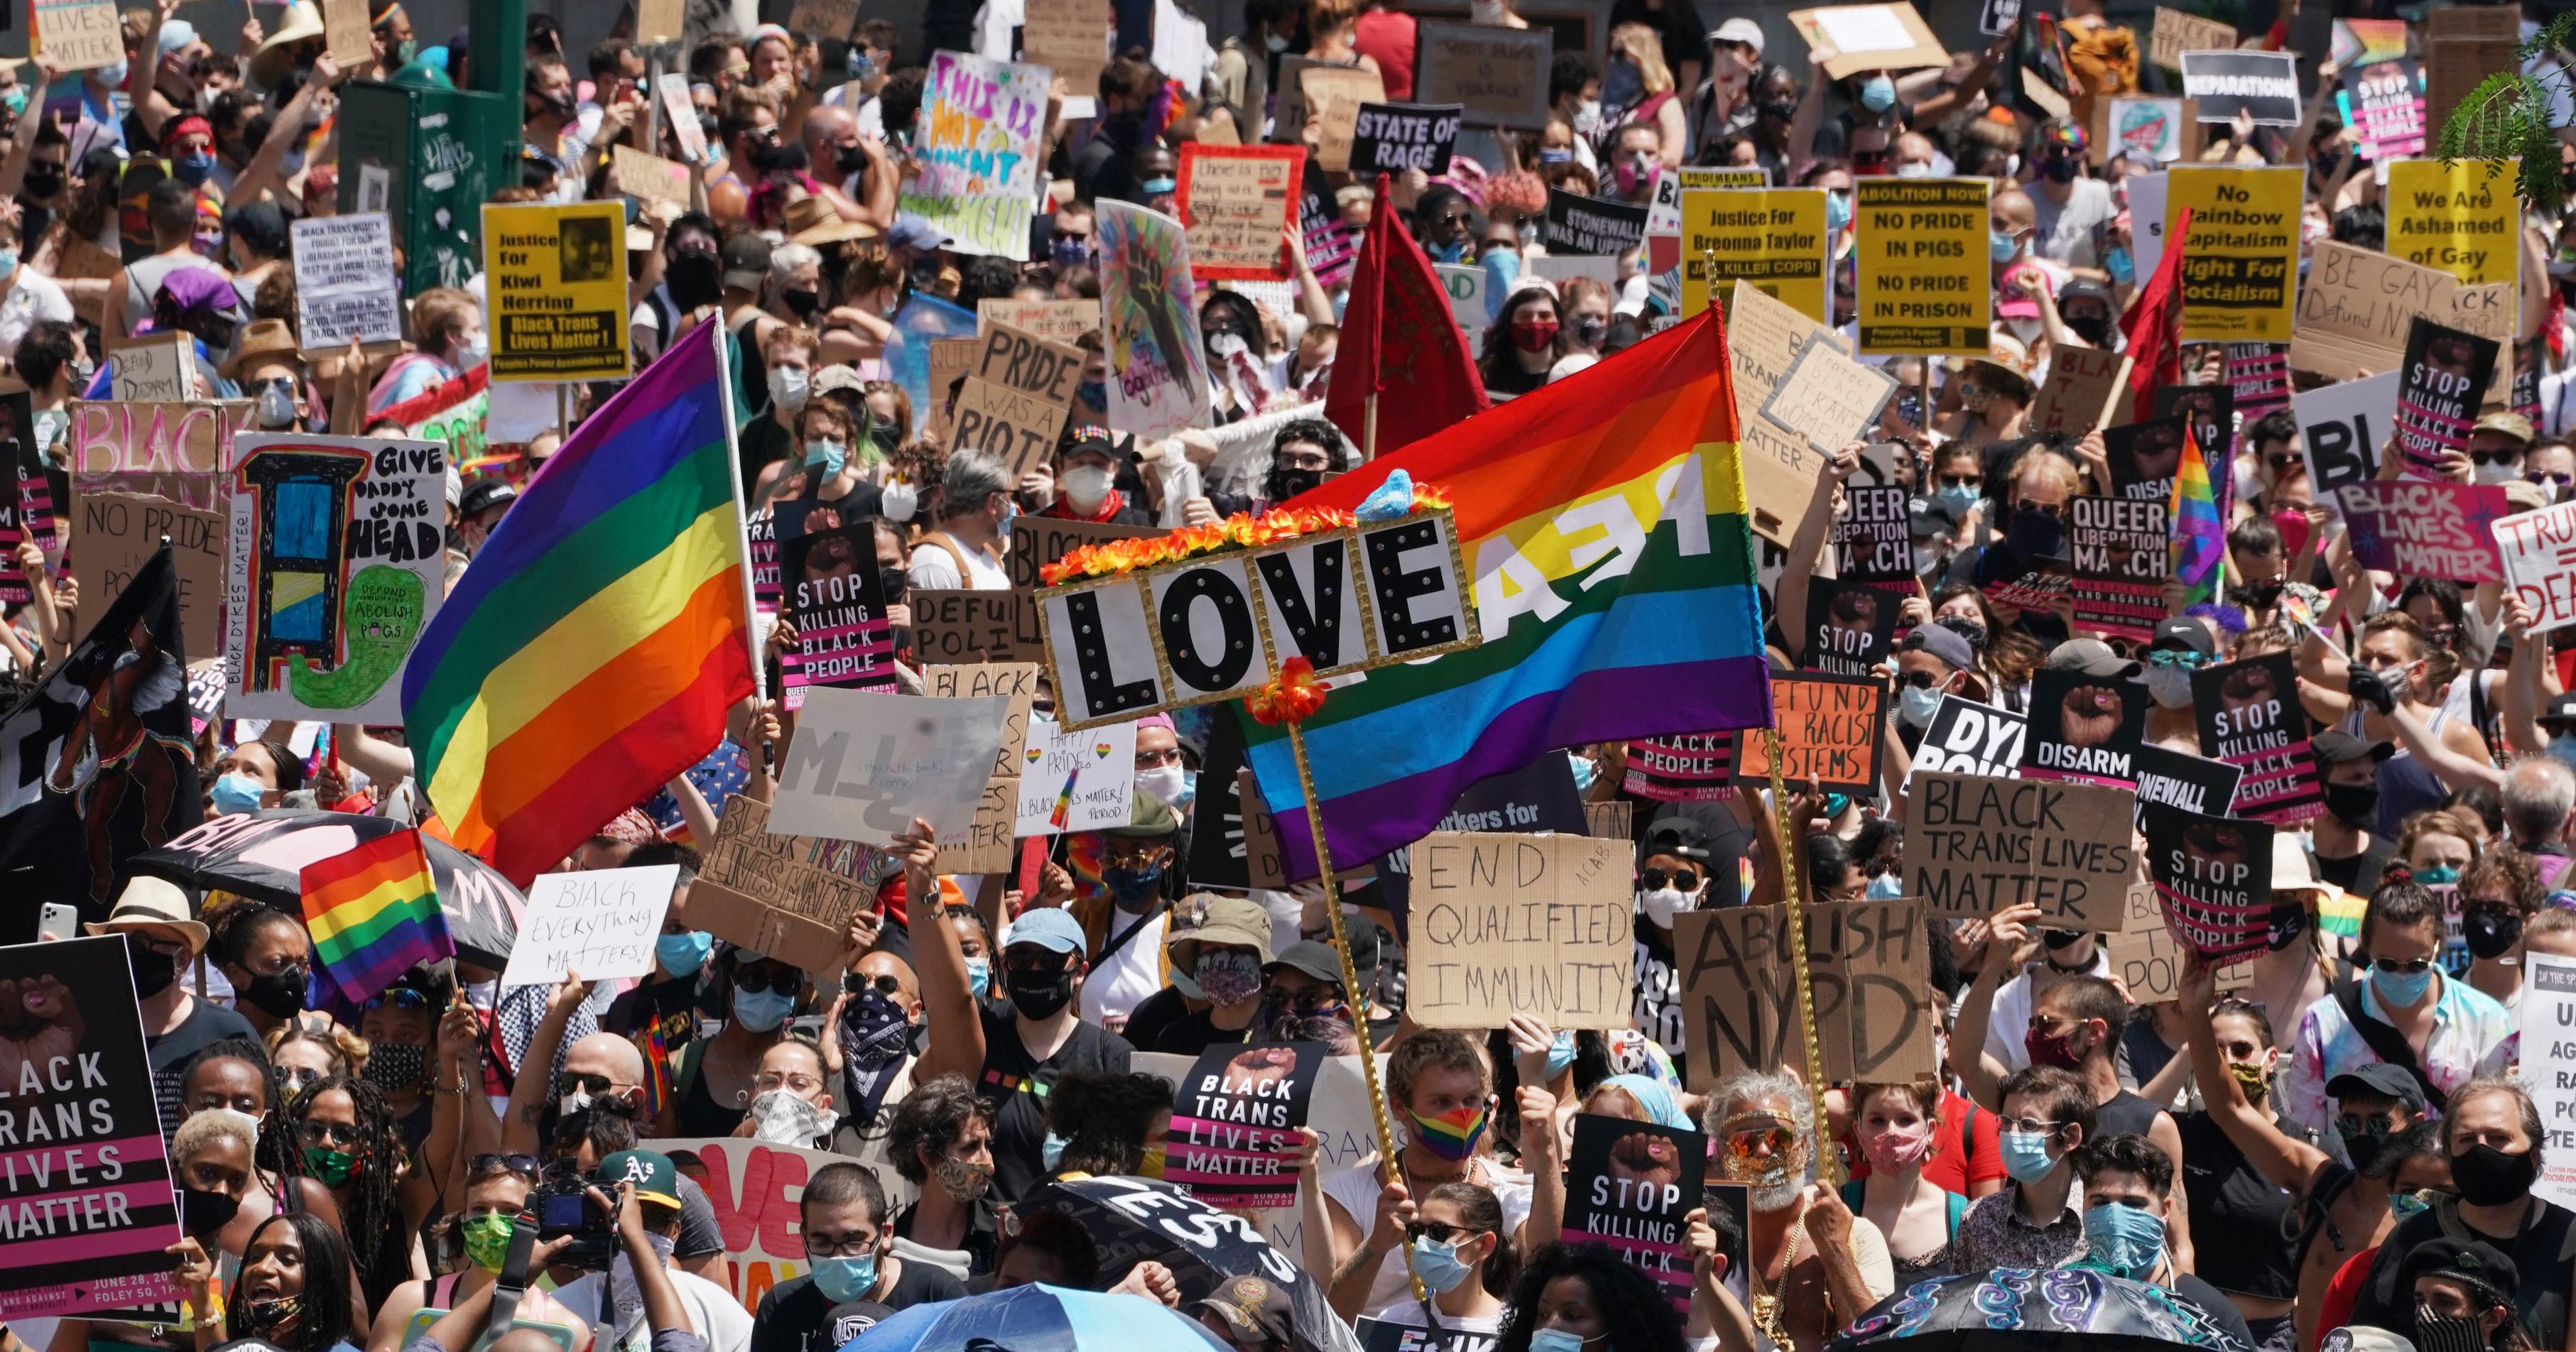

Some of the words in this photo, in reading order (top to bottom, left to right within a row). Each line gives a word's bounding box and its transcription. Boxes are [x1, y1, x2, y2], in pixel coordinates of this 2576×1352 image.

[47, 36, 117, 61] MATTER
[936, 54, 999, 119] THIS
[2185, 75, 2298, 99] REPARATIONS
[2358, 75, 2409, 100] STOP
[2362, 91, 2414, 114] KILLING
[930, 98, 985, 148] NOT
[1356, 112, 1420, 143] STATE
[1433, 115, 1460, 142] OF
[1374, 141, 1437, 169] RAGE
[1859, 183, 1941, 202] ABOLITION
[1946, 182, 1987, 201] NOW!
[2217, 185, 2250, 204] No
[2413, 190, 2447, 209] We
[2454, 190, 2493, 209] Are
[1566, 207, 1642, 239] STONEWALL
[1710, 207, 1767, 228] Justice
[1770, 207, 1795, 225] For
[1874, 212, 1904, 231] NO
[1909, 212, 1974, 231] PRIDE
[2190, 207, 2284, 226] ainbow
[2400, 215, 2506, 235] Ashamed
[499, 235, 558, 247] Justice
[1548, 219, 1575, 244] WAS
[1577, 229, 1597, 250] AN
[1692, 234, 1761, 253] Breonna
[1766, 232, 1816, 251] Taylor
[1886, 241, 1908, 258] IN
[1913, 241, 1965, 258] PIGS
[499, 253, 528, 267] For
[1724, 261, 1771, 276] KILLER
[1773, 258, 1817, 274] COPS!
[2246, 257, 2284, 278] For
[2408, 246, 2435, 266] of
[2440, 247, 2489, 269] Gay
[500, 274, 541, 290] Kiwi
[1876, 275, 1904, 292] NO
[1908, 275, 1969, 292] PRIDE
[2325, 249, 2366, 290] BE
[2381, 263, 2443, 310] GAY
[502, 294, 575, 311] Herring
[1874, 302, 1894, 319] IN
[1899, 302, 1973, 320] PRISON
[2304, 289, 2376, 329] Defund
[511, 319, 553, 334] Black
[558, 315, 599, 332] Trans
[511, 334, 550, 350] Lives
[554, 332, 600, 349] Matter
[979, 328, 1080, 403] PRIDE
[124, 379, 175, 400] DISARM
[1810, 365, 1866, 410] BLACK
[2411, 363, 2471, 399] STOP
[983, 386, 1034, 420] WAS
[1036, 404, 1054, 432] A
[1797, 384, 1856, 427] TRANS
[2406, 388, 2463, 419] KILLING
[74, 403, 254, 474] BLACK
[1776, 396, 1849, 452] WOMEN
[2401, 412, 2456, 440] BLACK
[952, 408, 1052, 475] RIOT!
[2400, 428, 2451, 453] PEOPLE
[375, 447, 444, 478] GIVE
[355, 479, 416, 499] DADDY
[2339, 484, 2464, 516] BLACK
[370, 499, 429, 519] SOME
[2072, 498, 2165, 535] QUEER
[85, 502, 129, 537] NO
[143, 508, 221, 557] PRIDE
[345, 519, 441, 563] HEAD
[2072, 528, 2166, 551] LIBERATION
[2377, 511, 2473, 547] LIVES
[2393, 542, 2501, 582] MATTER
[362, 585, 407, 597] DEFUND
[797, 573, 864, 609] STOP
[231, 584, 246, 637] DYKES
[355, 601, 413, 619] ABOLISH
[798, 604, 869, 633] KILLING
[1065, 518, 1459, 718] LOVE
[803, 628, 874, 657] BLACK
[1818, 623, 1874, 657] STOP
[227, 640, 244, 685] BLACK
[804, 653, 876, 680] PEOPLE
[1818, 654, 1867, 677] KILLING
[937, 669, 1032, 697] BLACK
[1803, 712, 1876, 747] RACIST
[2214, 699, 2282, 737] STOP
[1050, 726, 1085, 750] HAPPY
[2219, 729, 2288, 759] KILLING
[1626, 768, 1647, 781] QUEER
[1643, 750, 1714, 775] PEOPLE
[1759, 746, 1862, 780] SYSTEMS
[2037, 741, 2131, 778] DISARM
[1028, 796, 1056, 818] BLACK
[1085, 780, 1125, 806] MATTER!
[1624, 782, 1647, 795] MARCH
[1695, 785, 1732, 795] SUNDAY
[2232, 773, 2299, 804] PEOPLE
[1506, 796, 1538, 825] for
[1923, 779, 2064, 833] BLACK
[720, 795, 801, 862] BLACK
[808, 836, 886, 887] TRANS
[1923, 830, 2033, 865] TRANS
[2040, 836, 2129, 874] LIVES
[713, 833, 784, 899] LIVES
[777, 865, 874, 927] MATTER
[1430, 842, 1546, 890] END
[1575, 844, 1610, 887] ACAB
[2170, 849, 2249, 886] STOP
[1917, 866, 2087, 921] MATTER
[2170, 876, 2249, 908] KILLING
[1426, 903, 1628, 949] QUALIFIED
[2171, 896, 2246, 927] BLACK
[2174, 917, 2245, 949] PEOPLE
[1685, 905, 1915, 993] ABOLISH
[1423, 962, 1627, 1015] IMMUNITY
[1704, 967, 1918, 1078] NYPD
[1200, 1074, 1295, 1101] BLACK
[1195, 1095, 1288, 1128] TRANS
[1189, 1121, 1285, 1153] LIVES
[619, 1155, 655, 1184] A's
[1185, 1150, 1280, 1177] MATTER
[2548, 1166, 2565, 1176] LUCHA
[1252, 1193, 1294, 1201] SUNDAY
[1591, 1174, 1680, 1215] STOP
[1587, 1211, 1675, 1245] KILLING
[93, 1277, 126, 1291] JUNE
[131, 1275, 153, 1289] 28,
[94, 1290, 133, 1304] FOLEY
[137, 1286, 157, 1300] SQ,
[4, 1298, 23, 1308] AND
[26, 1292, 67, 1305] AGAINST
